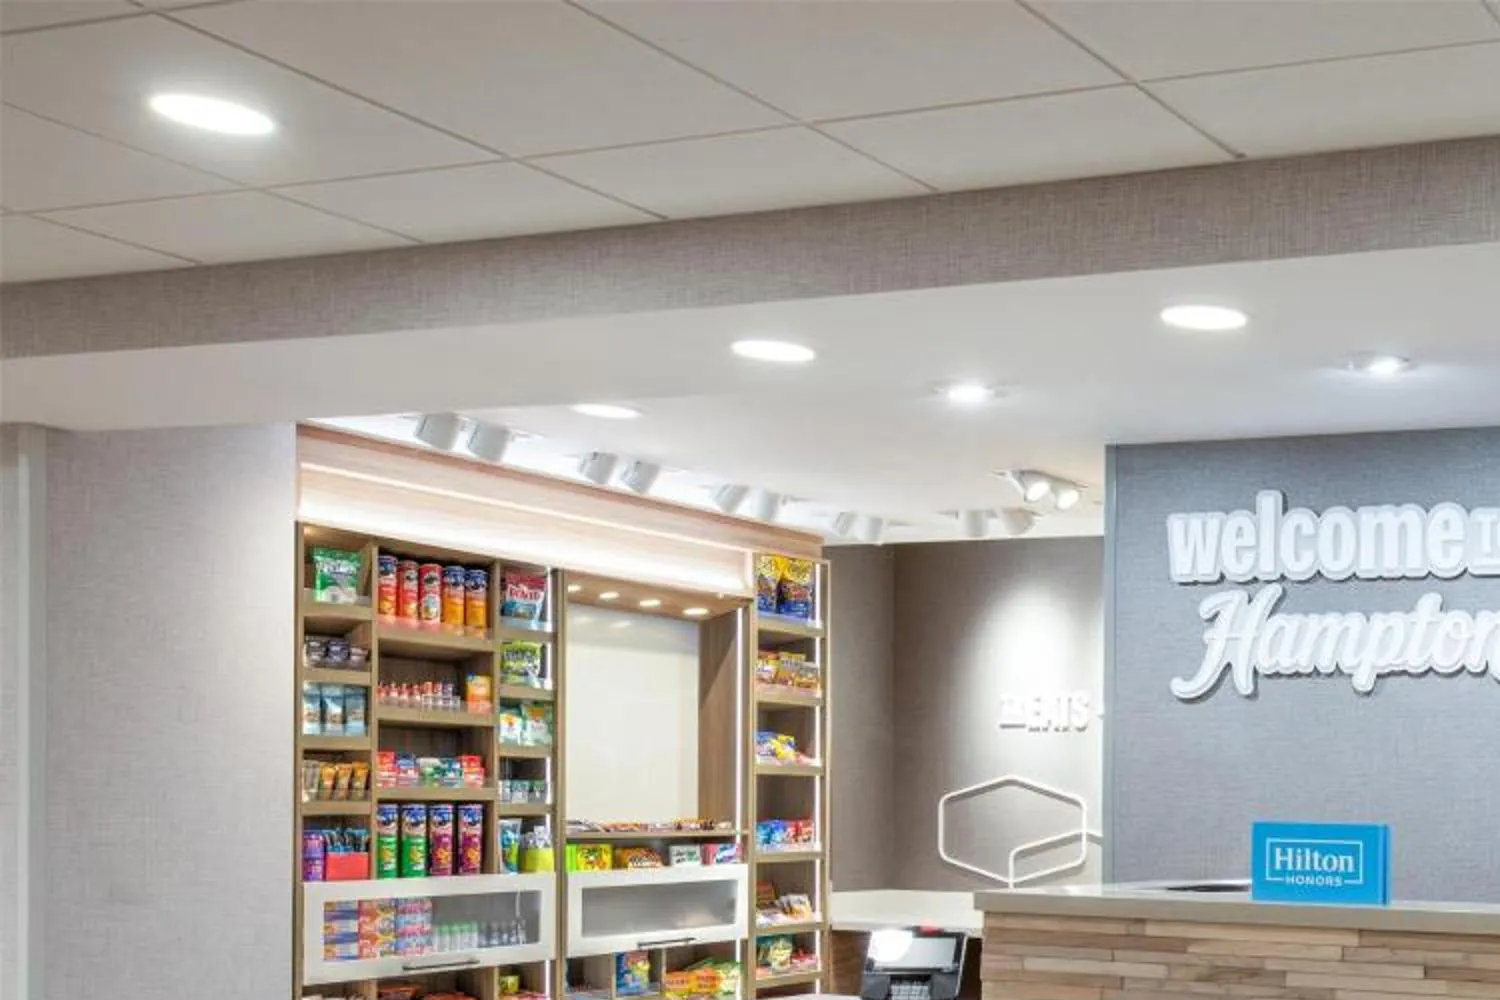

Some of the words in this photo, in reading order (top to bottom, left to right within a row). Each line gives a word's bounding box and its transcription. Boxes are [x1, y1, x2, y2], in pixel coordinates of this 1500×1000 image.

[1168, 489, 1466, 582] welcome
[1275, 847, 1355, 872] Hilton
[1285, 874, 1343, 886] HONORS
